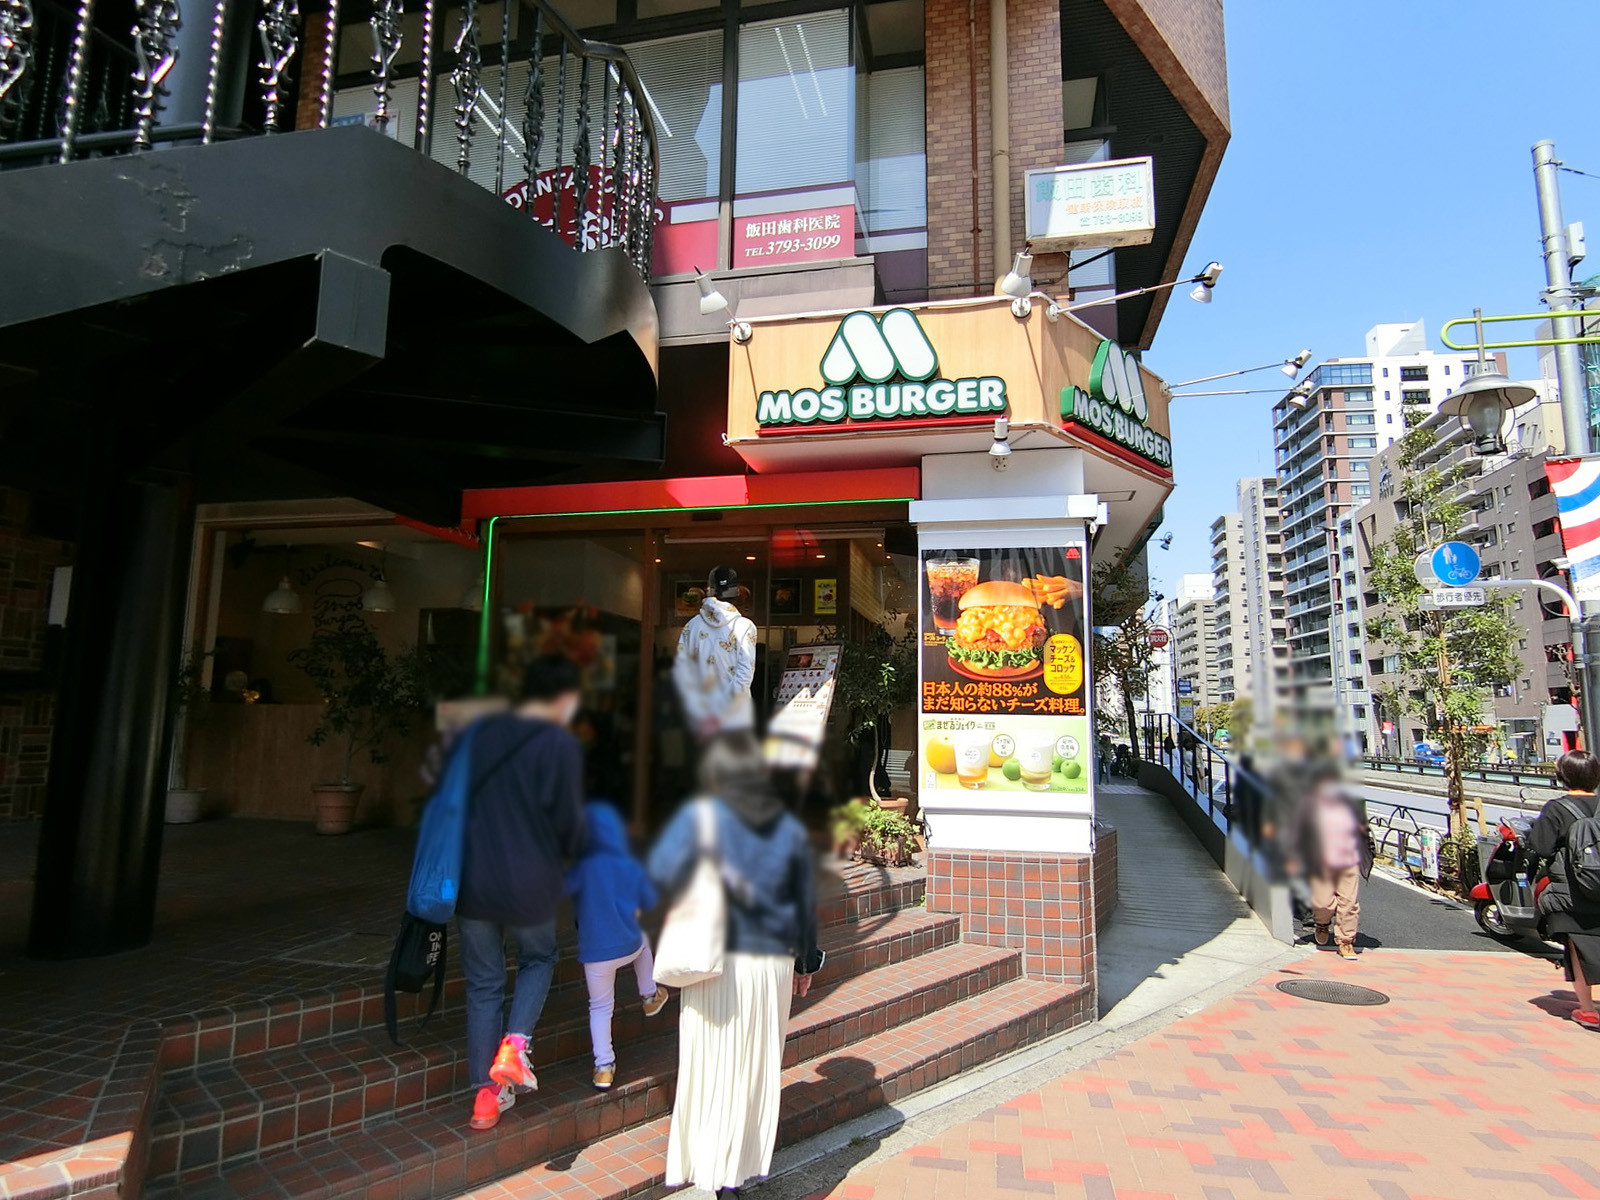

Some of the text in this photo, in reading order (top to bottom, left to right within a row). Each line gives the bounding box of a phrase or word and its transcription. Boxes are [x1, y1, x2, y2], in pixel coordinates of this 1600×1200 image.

[746, 214, 840, 238] 飯田歯科医院
[740, 234, 841, 257] TEL 3793-3099
[757, 378, 1006, 422] MOS BURGER
[1073, 386, 1172, 467] MOS BURGER
[1050, 664, 1076, 673] コロッケ
[923, 681, 1038, 697] 日本人の約88%が
[923, 696, 1086, 714] まだ知らないチーズ料理。
